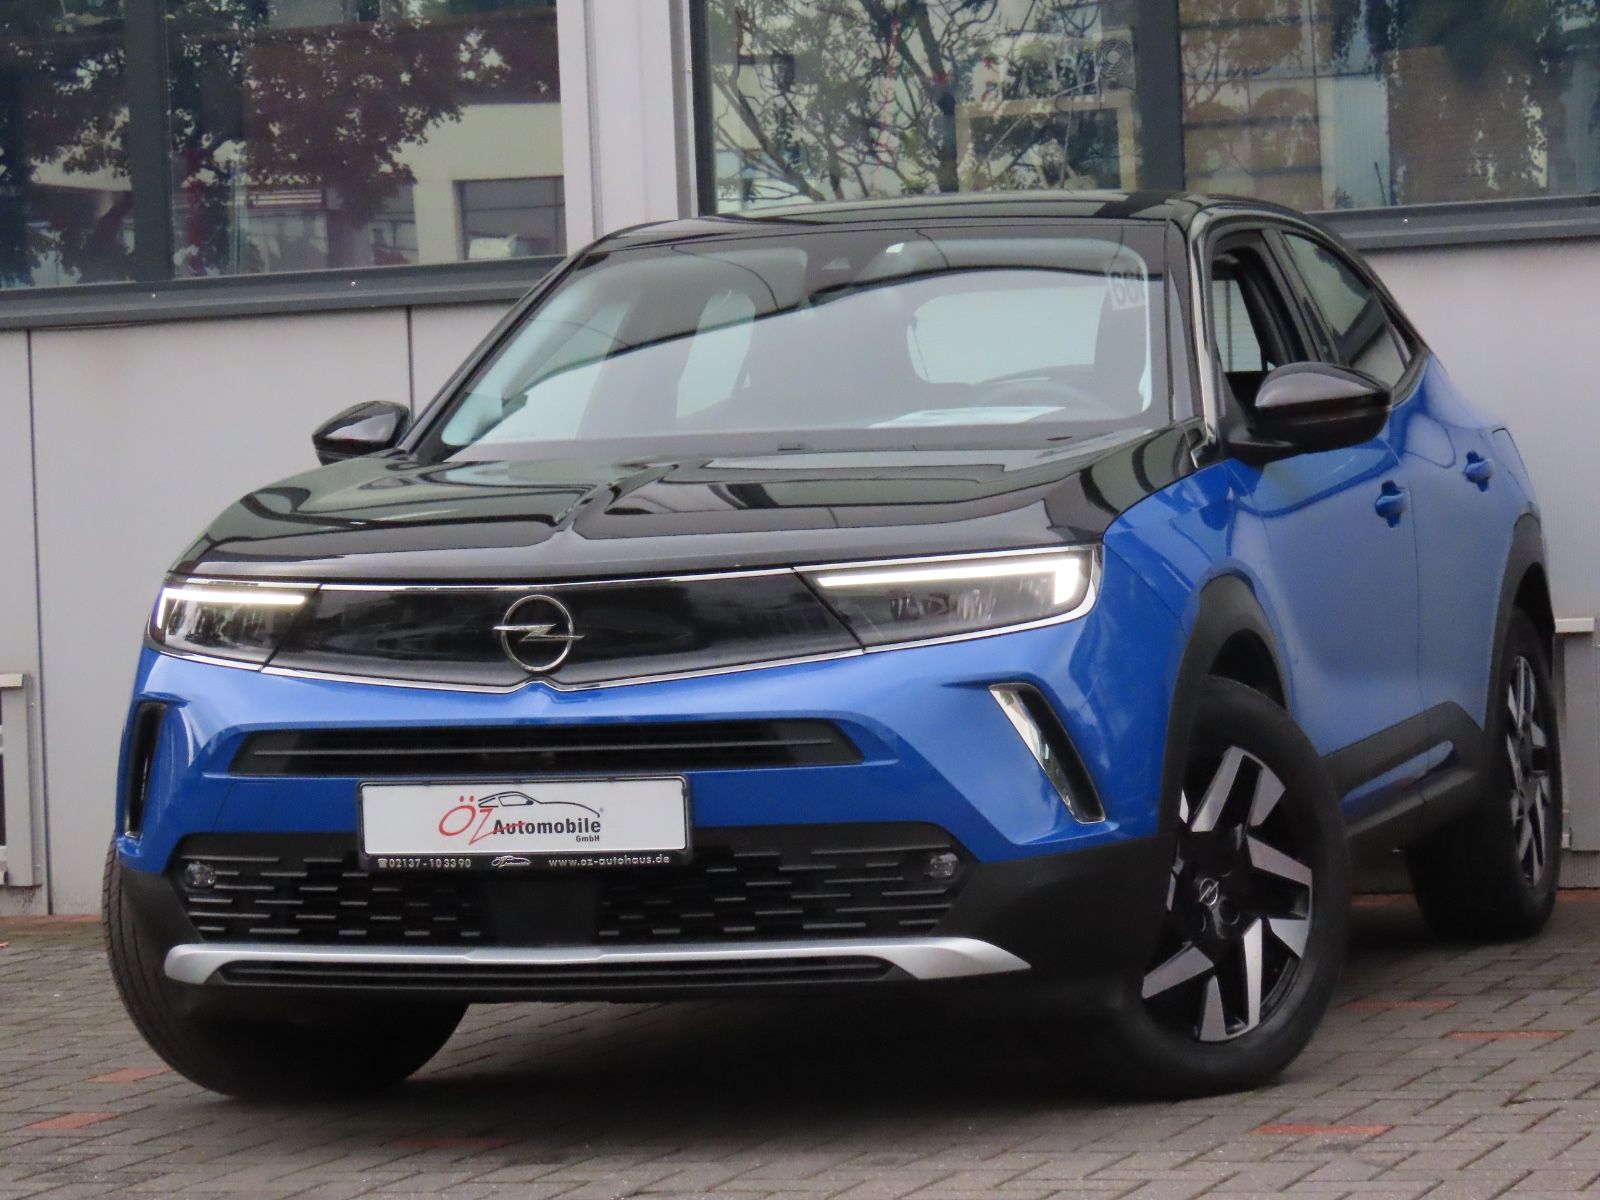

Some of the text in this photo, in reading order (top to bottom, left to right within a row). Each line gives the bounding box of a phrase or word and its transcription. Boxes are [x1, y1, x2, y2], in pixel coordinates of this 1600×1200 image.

[493, 817, 602, 835] Automobile
[575, 834, 600, 843] GmbH
[548, 854, 670, 867] www.oz-autohaus.de
